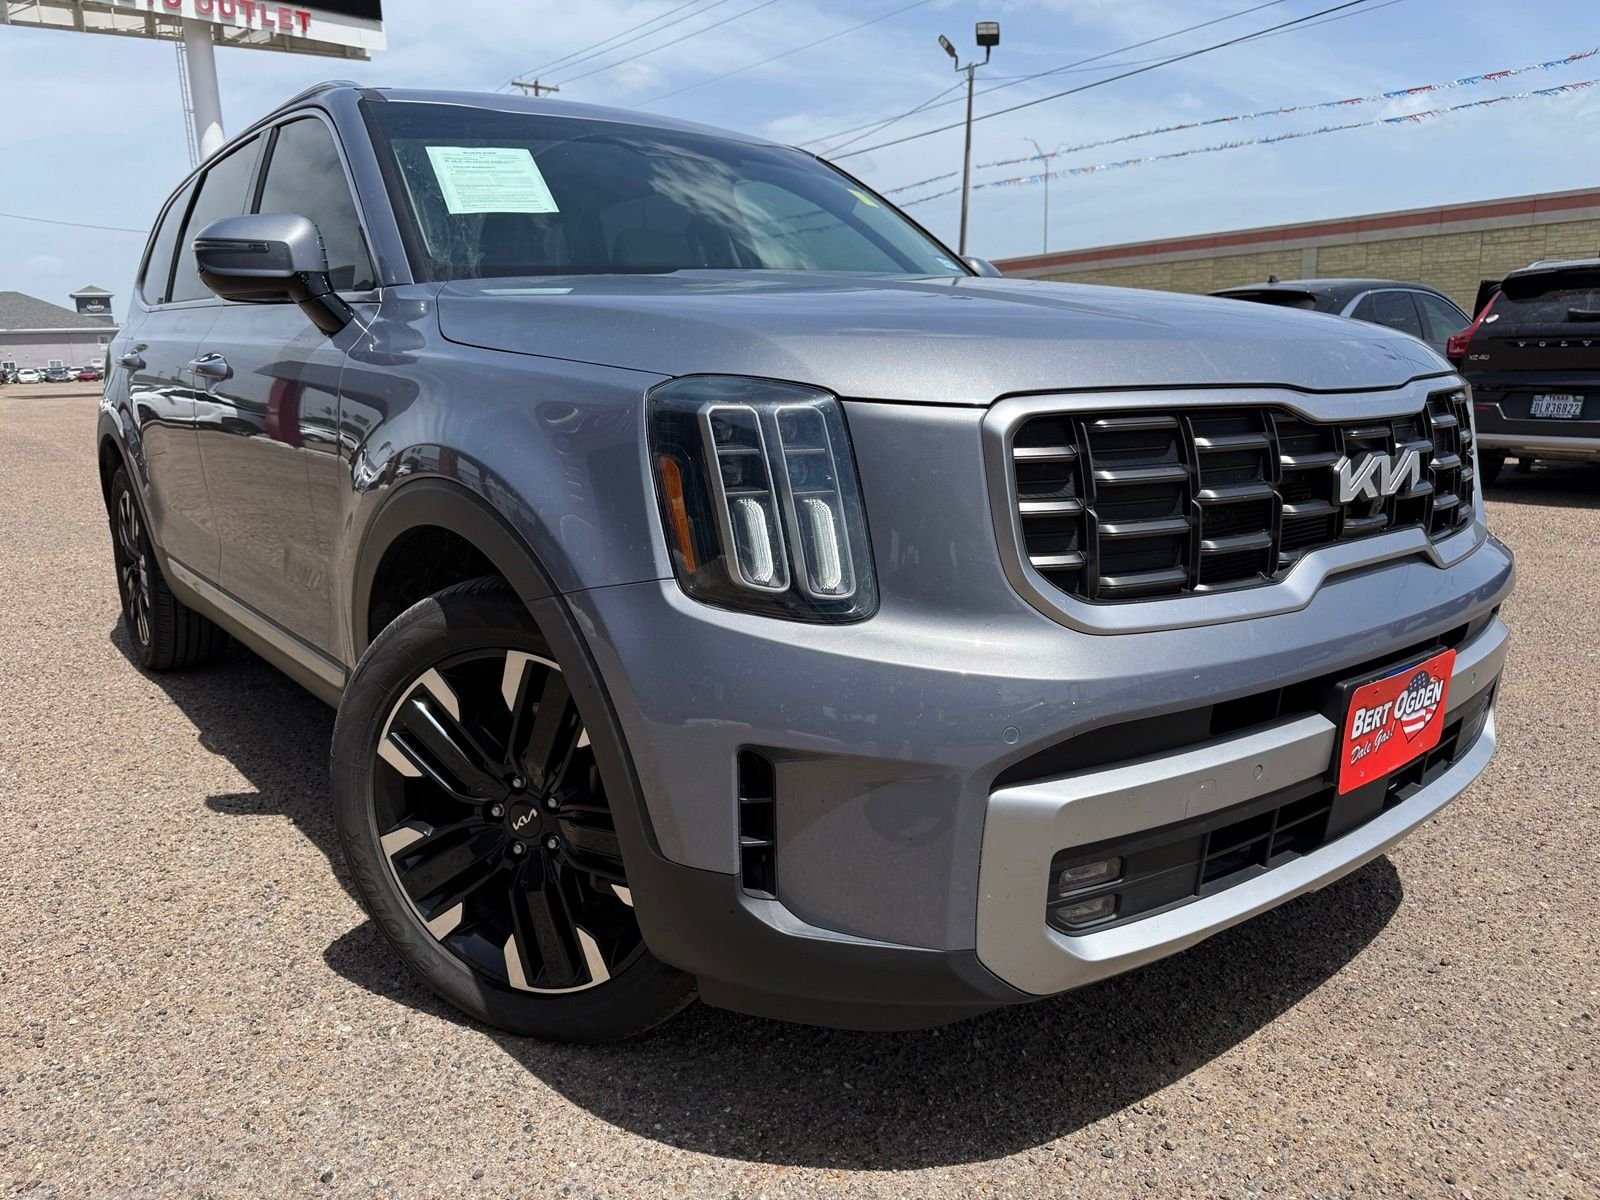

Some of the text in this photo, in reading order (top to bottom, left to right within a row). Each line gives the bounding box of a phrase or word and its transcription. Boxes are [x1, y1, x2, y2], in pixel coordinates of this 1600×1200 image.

[195, 0, 311, 32] OUTLET
[1350, 679, 1444, 740] BERT OGDEN
[1350, 719, 1396, 765] Dale Gas!
